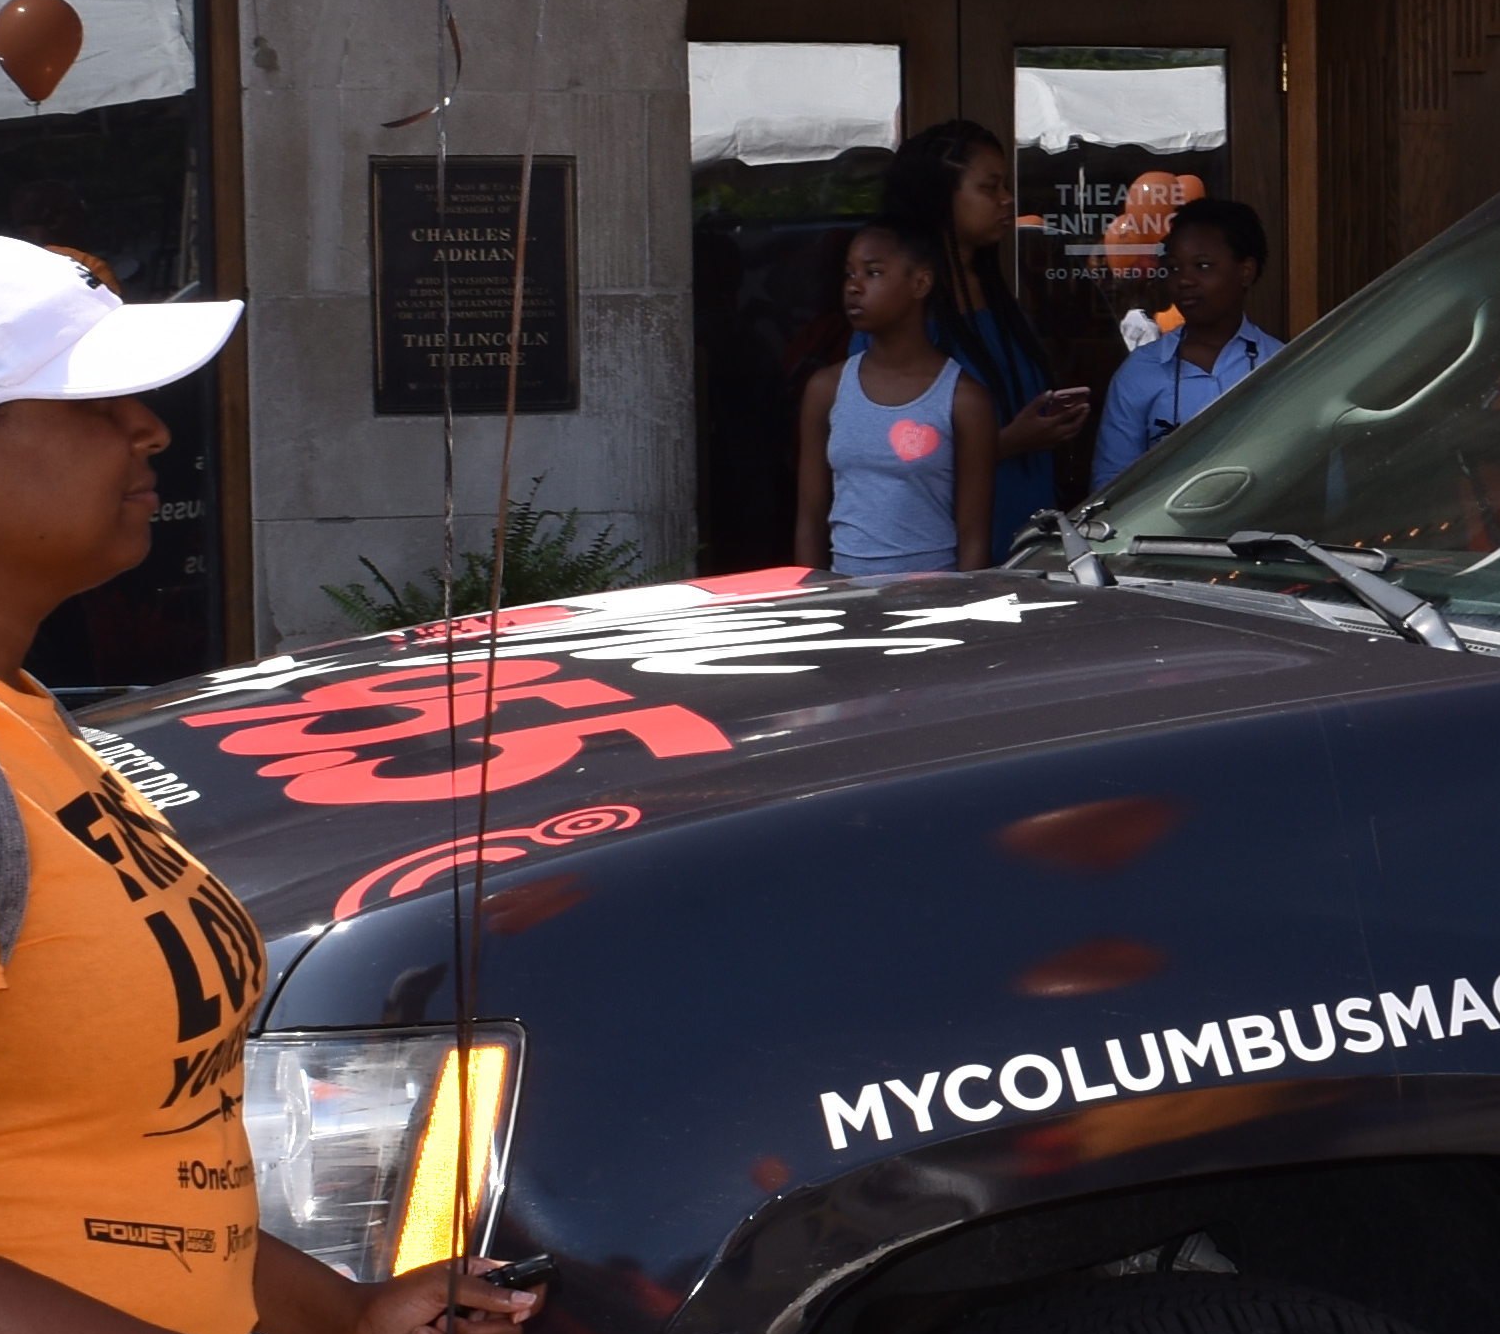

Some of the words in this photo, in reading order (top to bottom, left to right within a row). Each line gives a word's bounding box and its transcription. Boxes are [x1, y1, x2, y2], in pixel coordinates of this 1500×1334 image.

[1055, 183, 1186, 206] THEATRE
[411, 227, 512, 243] CHARLES
[433, 247, 516, 262] ADRIAN
[443, 276, 509, 286] NVISIONED
[1045, 267, 1067, 280] GO
[1071, 267, 1108, 280] PAST
[1112, 267, 1142, 279] RED
[1146, 267, 1169, 279] DO
[429, 298, 520, 309] ENERTAINMEN
[404, 333, 446, 348] THE
[454, 332, 550, 347] LINCOLN
[428, 353, 527, 368] THEATRE
[144, 872, 264, 1044] LOV
[89, 1220, 193, 1274] POWER
